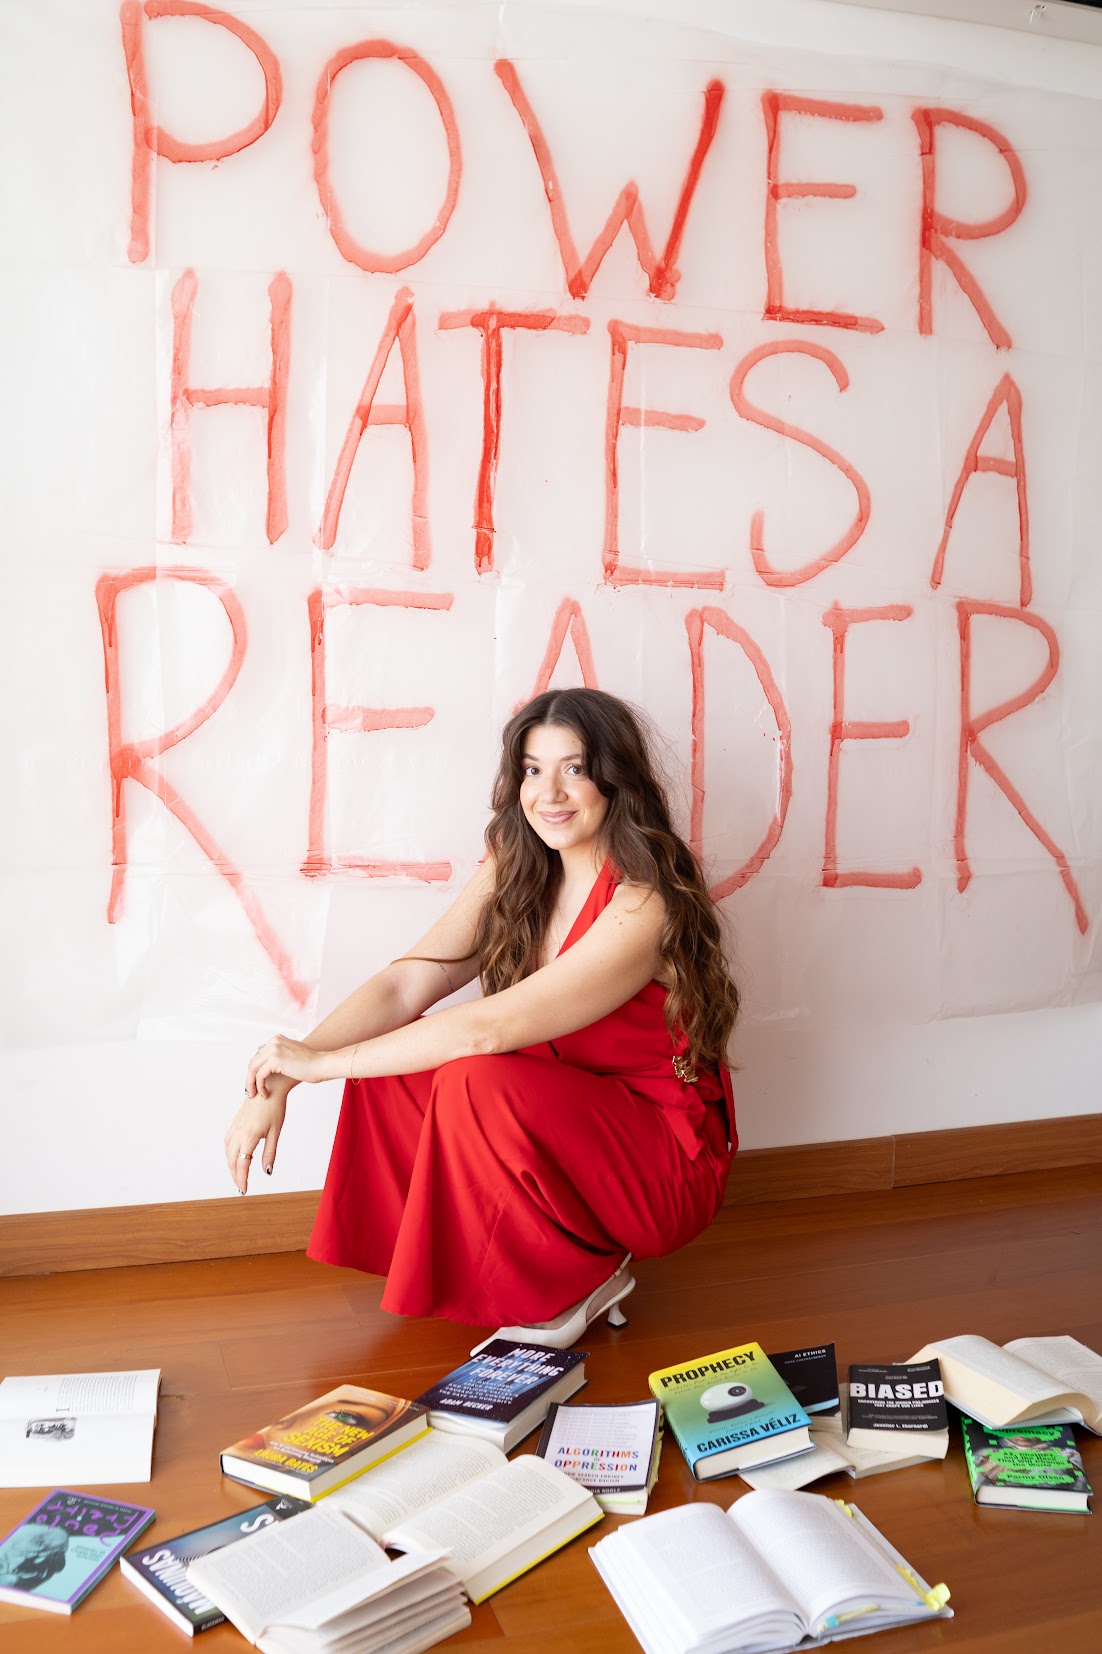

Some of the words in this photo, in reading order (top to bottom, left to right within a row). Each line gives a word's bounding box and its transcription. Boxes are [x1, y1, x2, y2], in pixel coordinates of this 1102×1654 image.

[120, 0, 1028, 350] POWER
[167, 268, 873, 589] HATES
[929, 372, 1034, 608] A
[471, 1353, 565, 1377] EVERYTHING
[508, 1348, 556, 1362] MORE
[802, 1349, 827, 1357] ETHICS
[469, 1367, 541, 1385] FOREVER
[660, 1351, 756, 1388] PROPHECY
[849, 1380, 945, 1400] BIASED
[304, 1426, 337, 1440] AGE
[334, 1434, 358, 1445] OF
[313, 1416, 343, 1432] THE
[340, 1424, 375, 1441] NEW
[696, 1426, 761, 1453] CARISSA
[759, 1413, 801, 1433] VÉLIZ
[283, 1431, 350, 1457] SEXISM
[557, 1447, 639, 1459] ALGORITHMS
[253, 1449, 288, 1463] LAURA
[284, 1457, 319, 1474] BATES
[554, 1459, 638, 1471] OPPRESSION
[142, 1549, 217, 1616] MÁQUINAS
